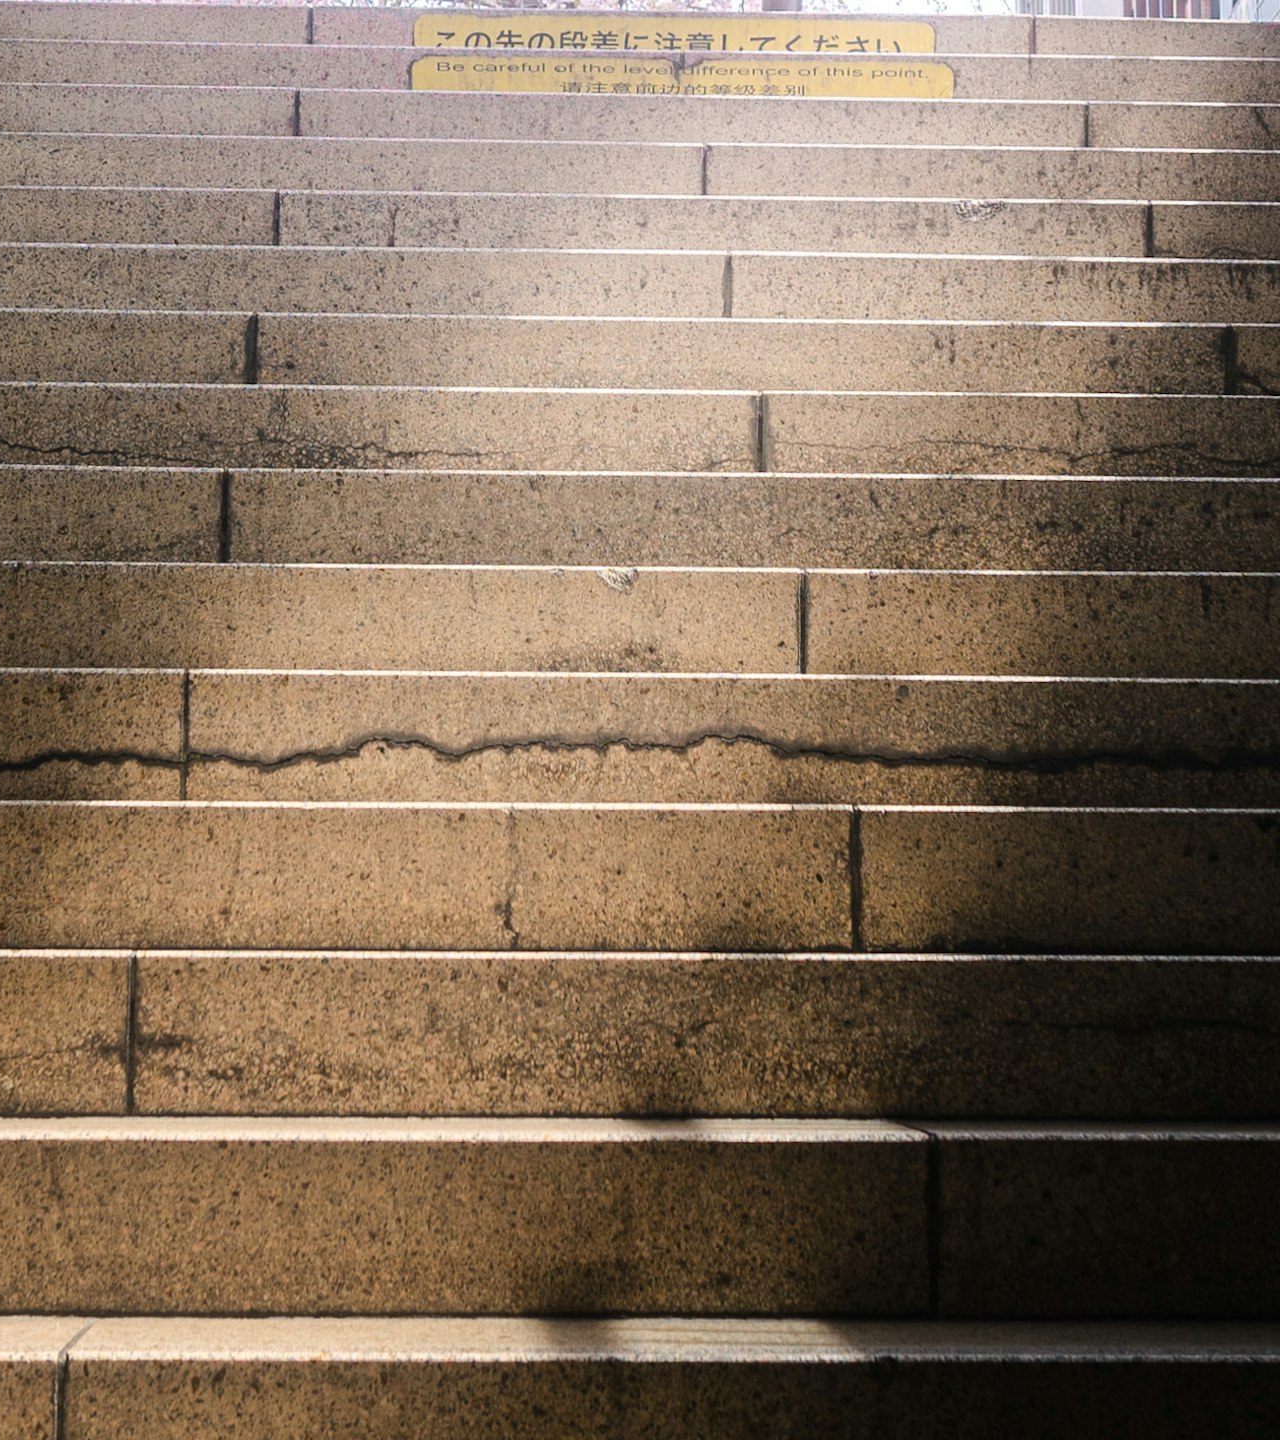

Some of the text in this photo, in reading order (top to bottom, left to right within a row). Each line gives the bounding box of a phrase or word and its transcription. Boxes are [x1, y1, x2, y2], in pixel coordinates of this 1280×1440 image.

[436, 61, 464, 72] Be
[473, 61, 546, 73] careful
[554, 62, 575, 73] of
[582, 63, 615, 74] the
[624, 63, 673, 75] level
[798, 65, 821, 77] of
[826, 66, 863, 77] this
[871, 66, 929, 80] point.
